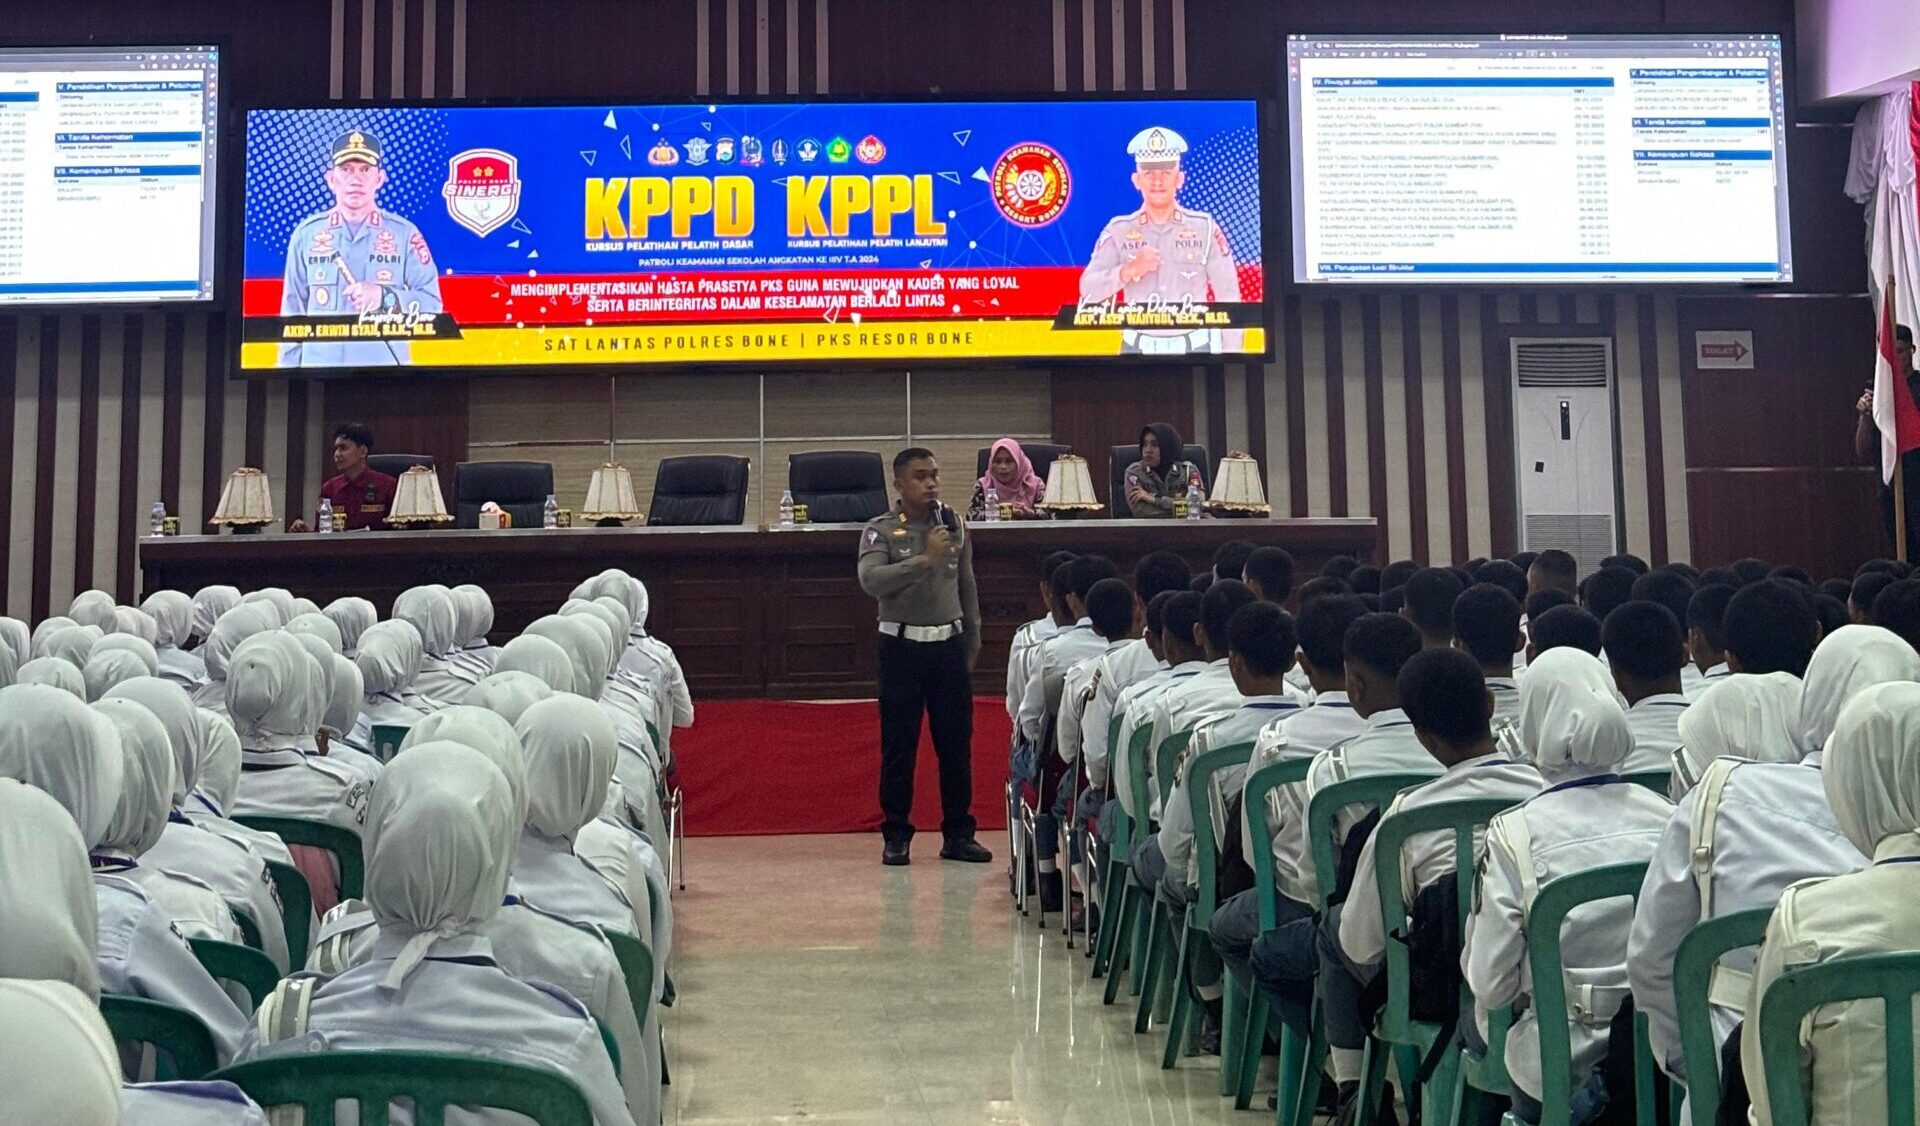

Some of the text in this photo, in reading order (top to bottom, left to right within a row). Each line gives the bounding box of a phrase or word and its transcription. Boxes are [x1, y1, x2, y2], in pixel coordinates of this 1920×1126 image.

[445, 182, 517, 197] SINERGI
[584, 174, 947, 239] KPPD KPPL
[585, 239, 753, 251] KURSUS PELATIHAN PELATIH DASAR
[787, 238, 948, 248] KURSUS PELATIHAN PELATIH LANJUTAN
[1175, 239, 1203, 249] POLRI
[369, 254, 401, 264] POLRI
[638, 258, 675, 266] PATROLI
[676, 257, 725, 266] KEAMANAN
[727, 256, 766, 265] SEKOLAH
[768, 256, 815, 264] ANGKATAN
[816, 255, 828, 264] KE
[844, 255, 858, 263] T.A
[859, 255, 879, 263] 2024
[511, 277, 1019, 297] MENGIMPLEMENTASIKAN HASTA PRASETYA PKS GUNA MEWUJUDKAN KADER YANG LOYAL
[587, 293, 945, 312] SERTA BERINTEGRITAS DALAM KESELAMATAN BERLALU LINTAS
[283, 325, 314, 338] AKBP.
[316, 324, 349, 337] ERWIN
[544, 332, 972, 351] SAT LANTAS POLRES BONE PKS RESOR BONE
